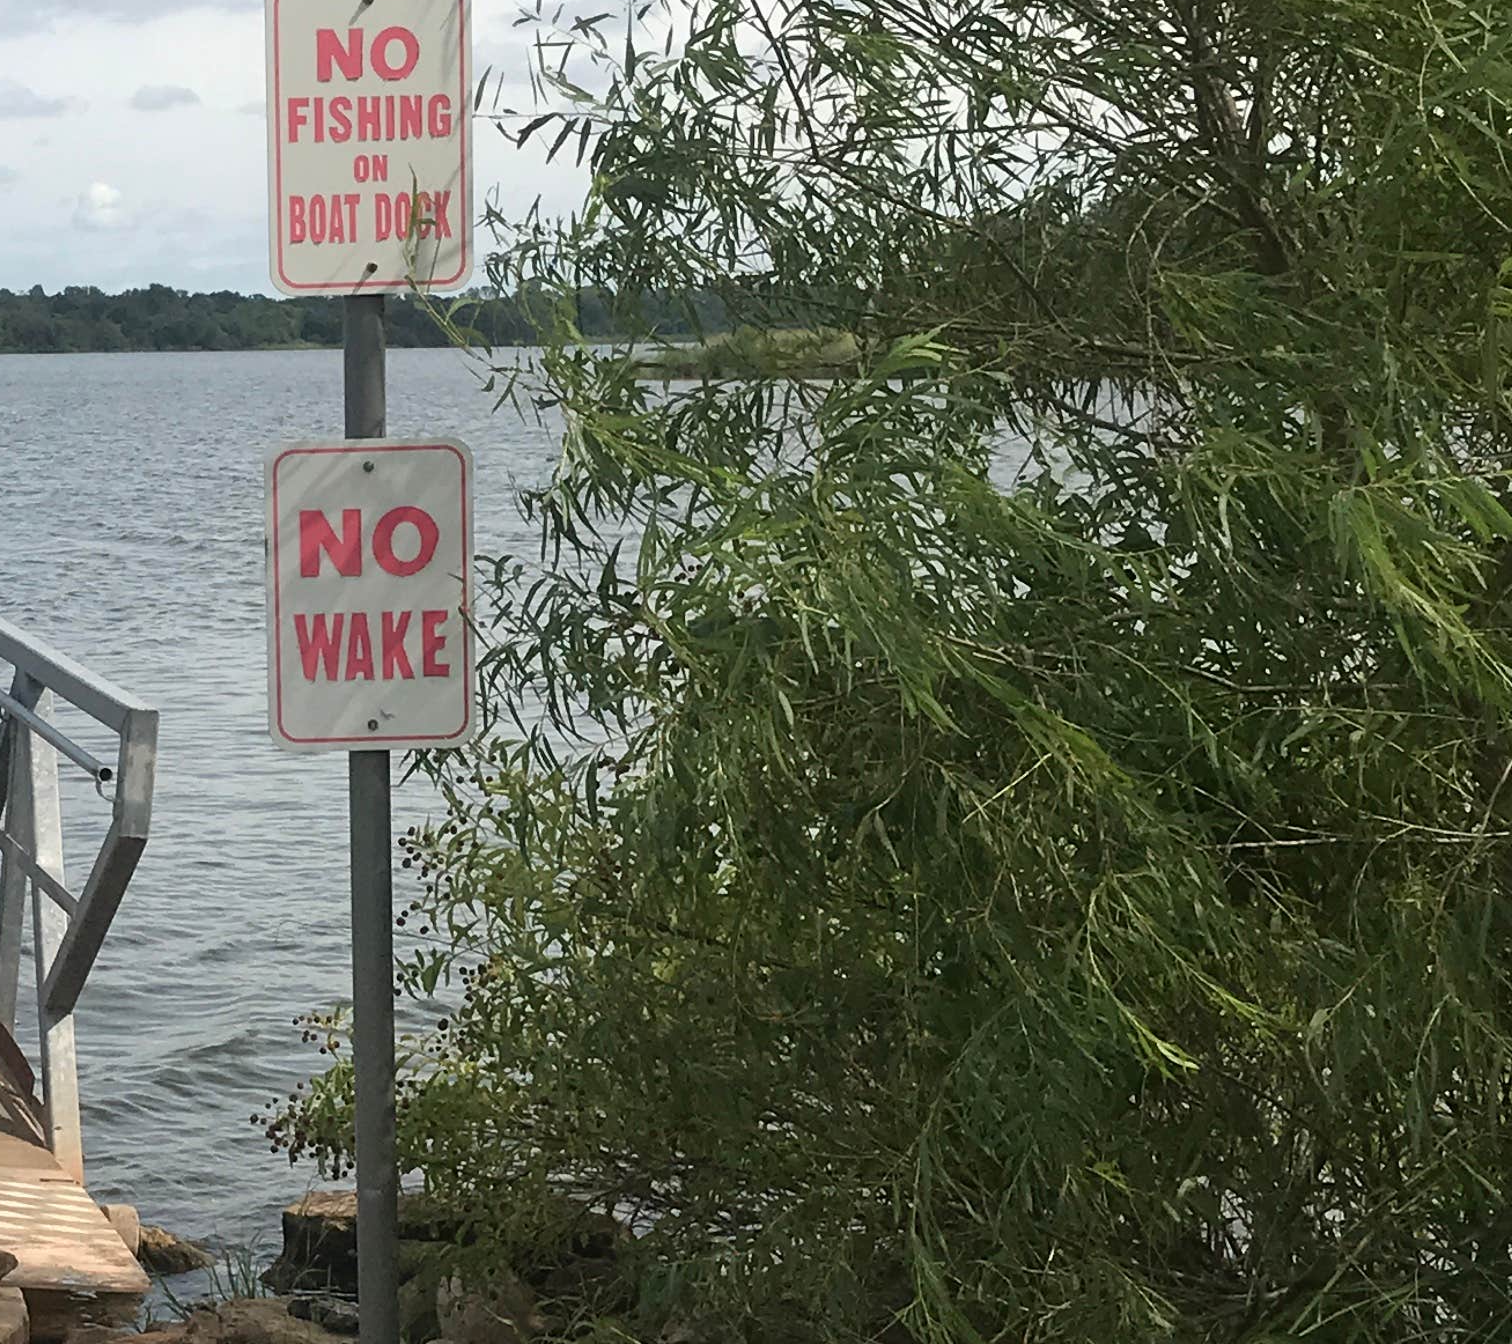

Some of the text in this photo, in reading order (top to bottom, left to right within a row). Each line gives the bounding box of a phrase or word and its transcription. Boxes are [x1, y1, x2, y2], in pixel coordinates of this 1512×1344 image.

[316, 26, 420, 82] NO
[288, 94, 451, 143] FISHING
[353, 155, 388, 183] ON
[289, 193, 360, 244] BOAT
[299, 506, 440, 577] NO
[294, 610, 450, 682] WAKE
